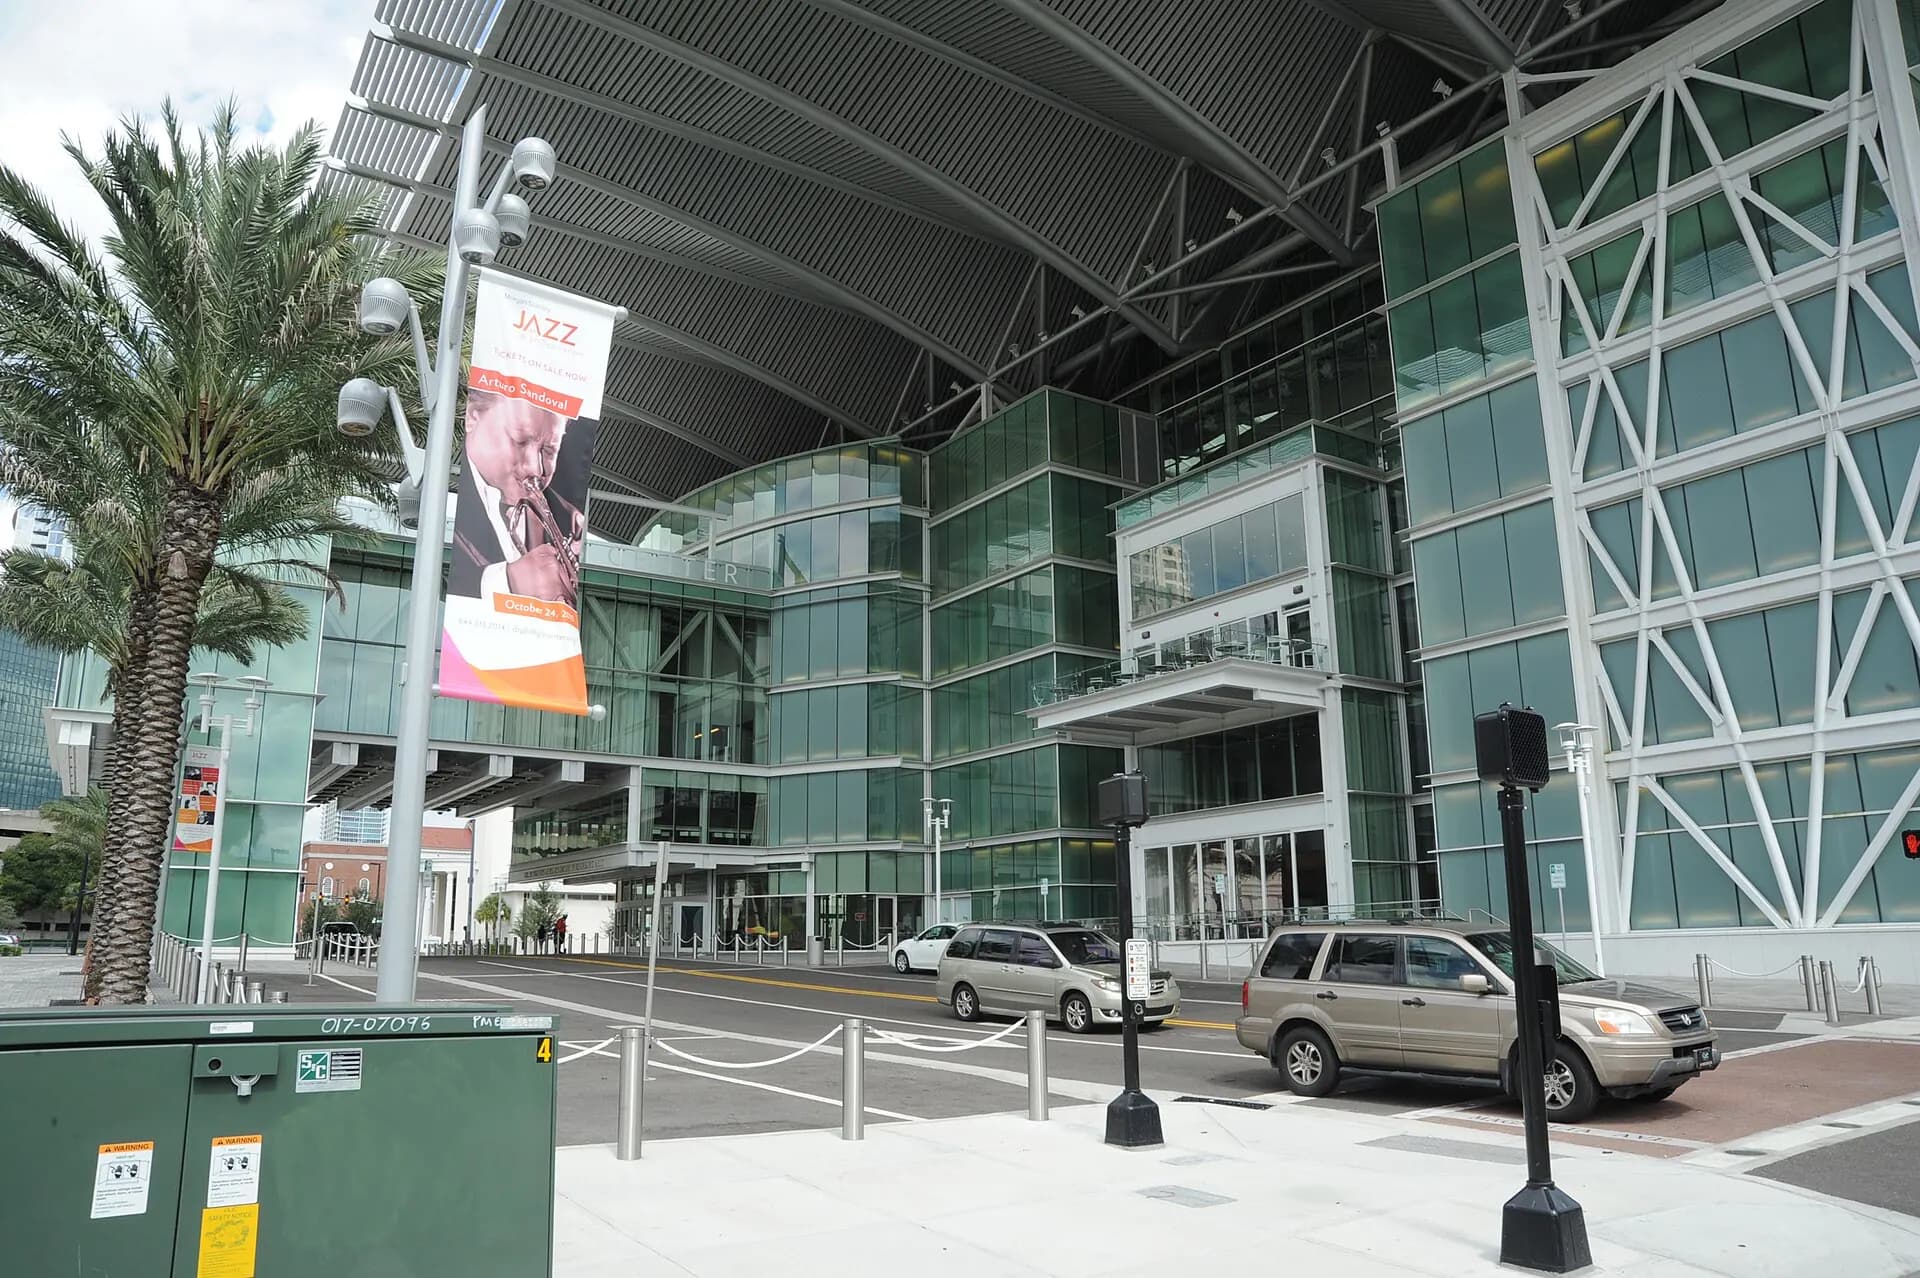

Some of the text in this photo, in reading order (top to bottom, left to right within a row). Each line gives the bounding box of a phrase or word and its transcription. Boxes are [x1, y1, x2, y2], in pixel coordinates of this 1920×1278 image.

[512, 310, 578, 346] JAZZ
[478, 374, 568, 411] Arturo Sandoval
[504, 599, 542, 614] October
[321, 1016, 431, 1033] 017-07096
[537, 1037, 552, 1063] 4
[114, 1143, 149, 1152] WARNING
[225, 1136, 258, 1145] WARNING
